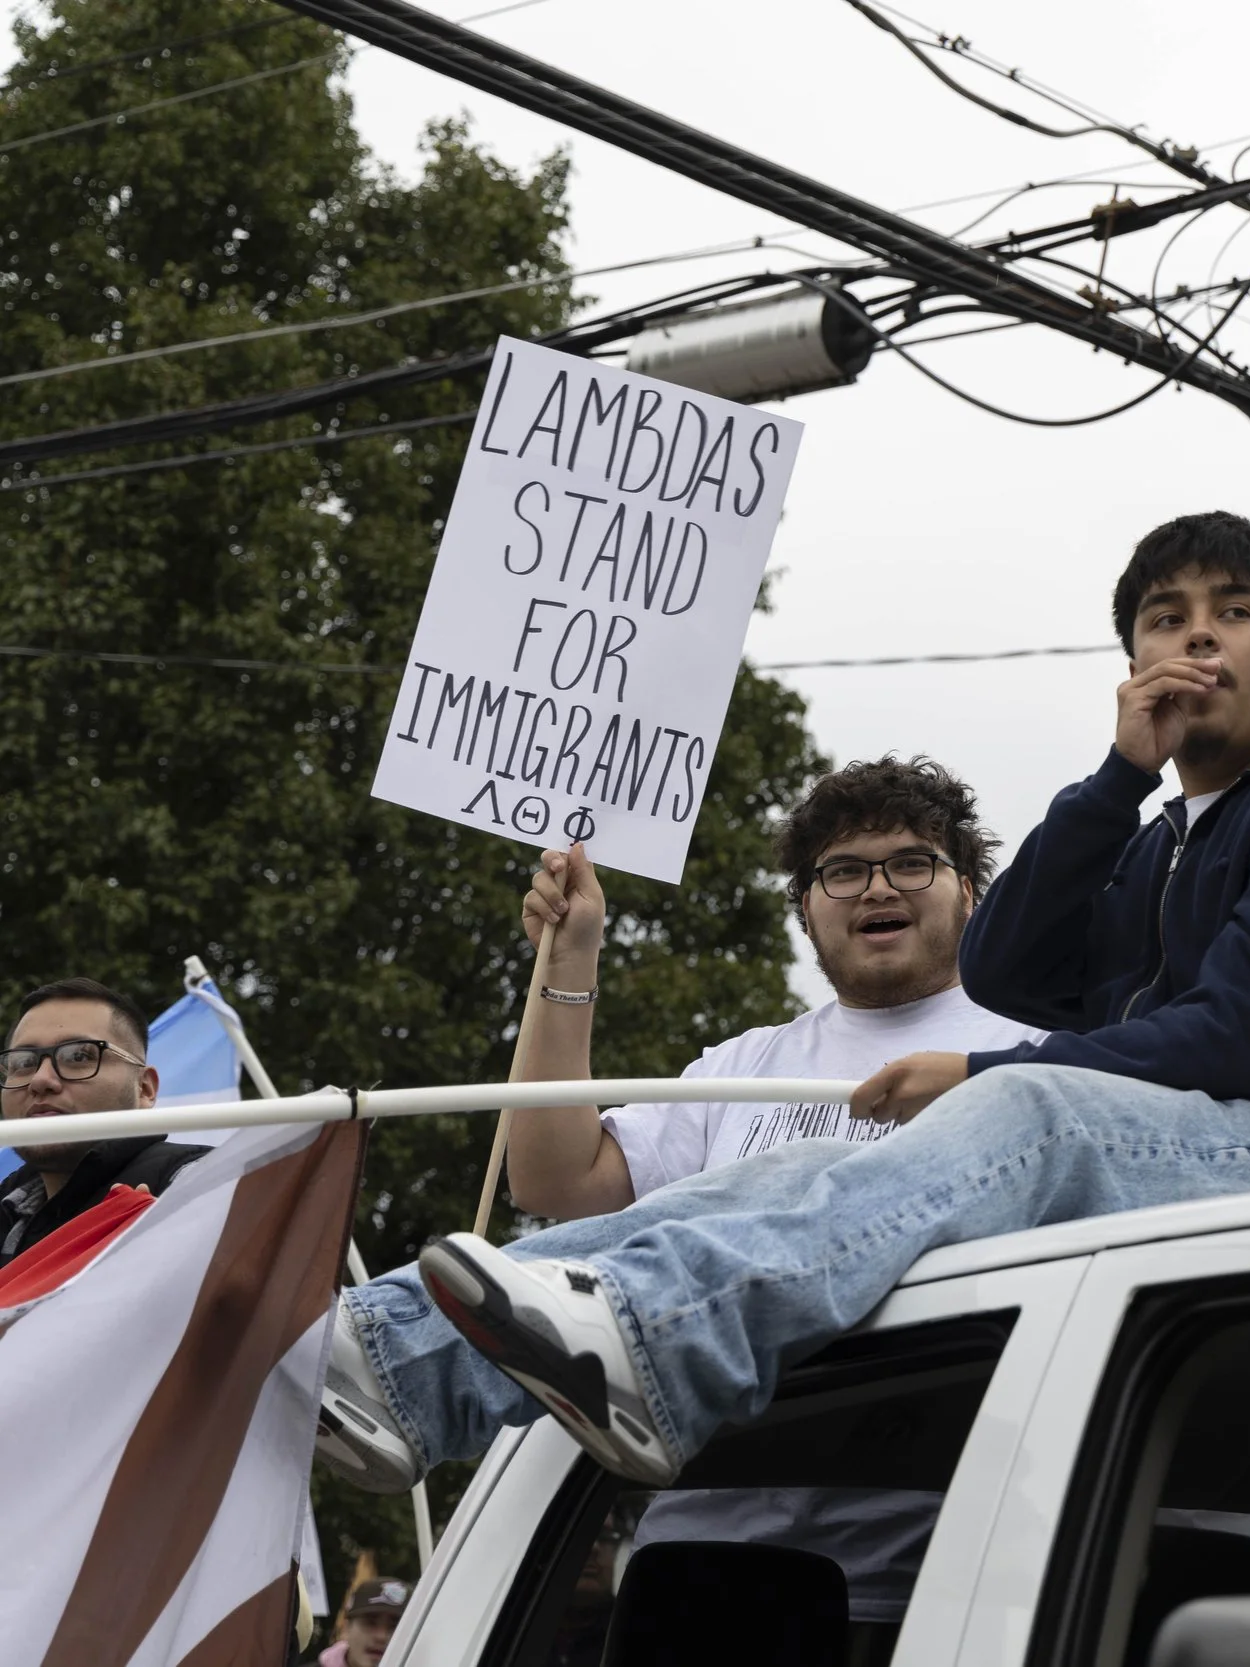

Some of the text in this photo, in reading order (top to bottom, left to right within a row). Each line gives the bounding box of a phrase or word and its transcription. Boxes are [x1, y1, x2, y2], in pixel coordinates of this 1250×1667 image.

[480, 352, 779, 517] LAMBDAS
[505, 481, 707, 615] STAND
[513, 598, 637, 702] FOR
[397, 662, 704, 822] IMMIGRANTS
